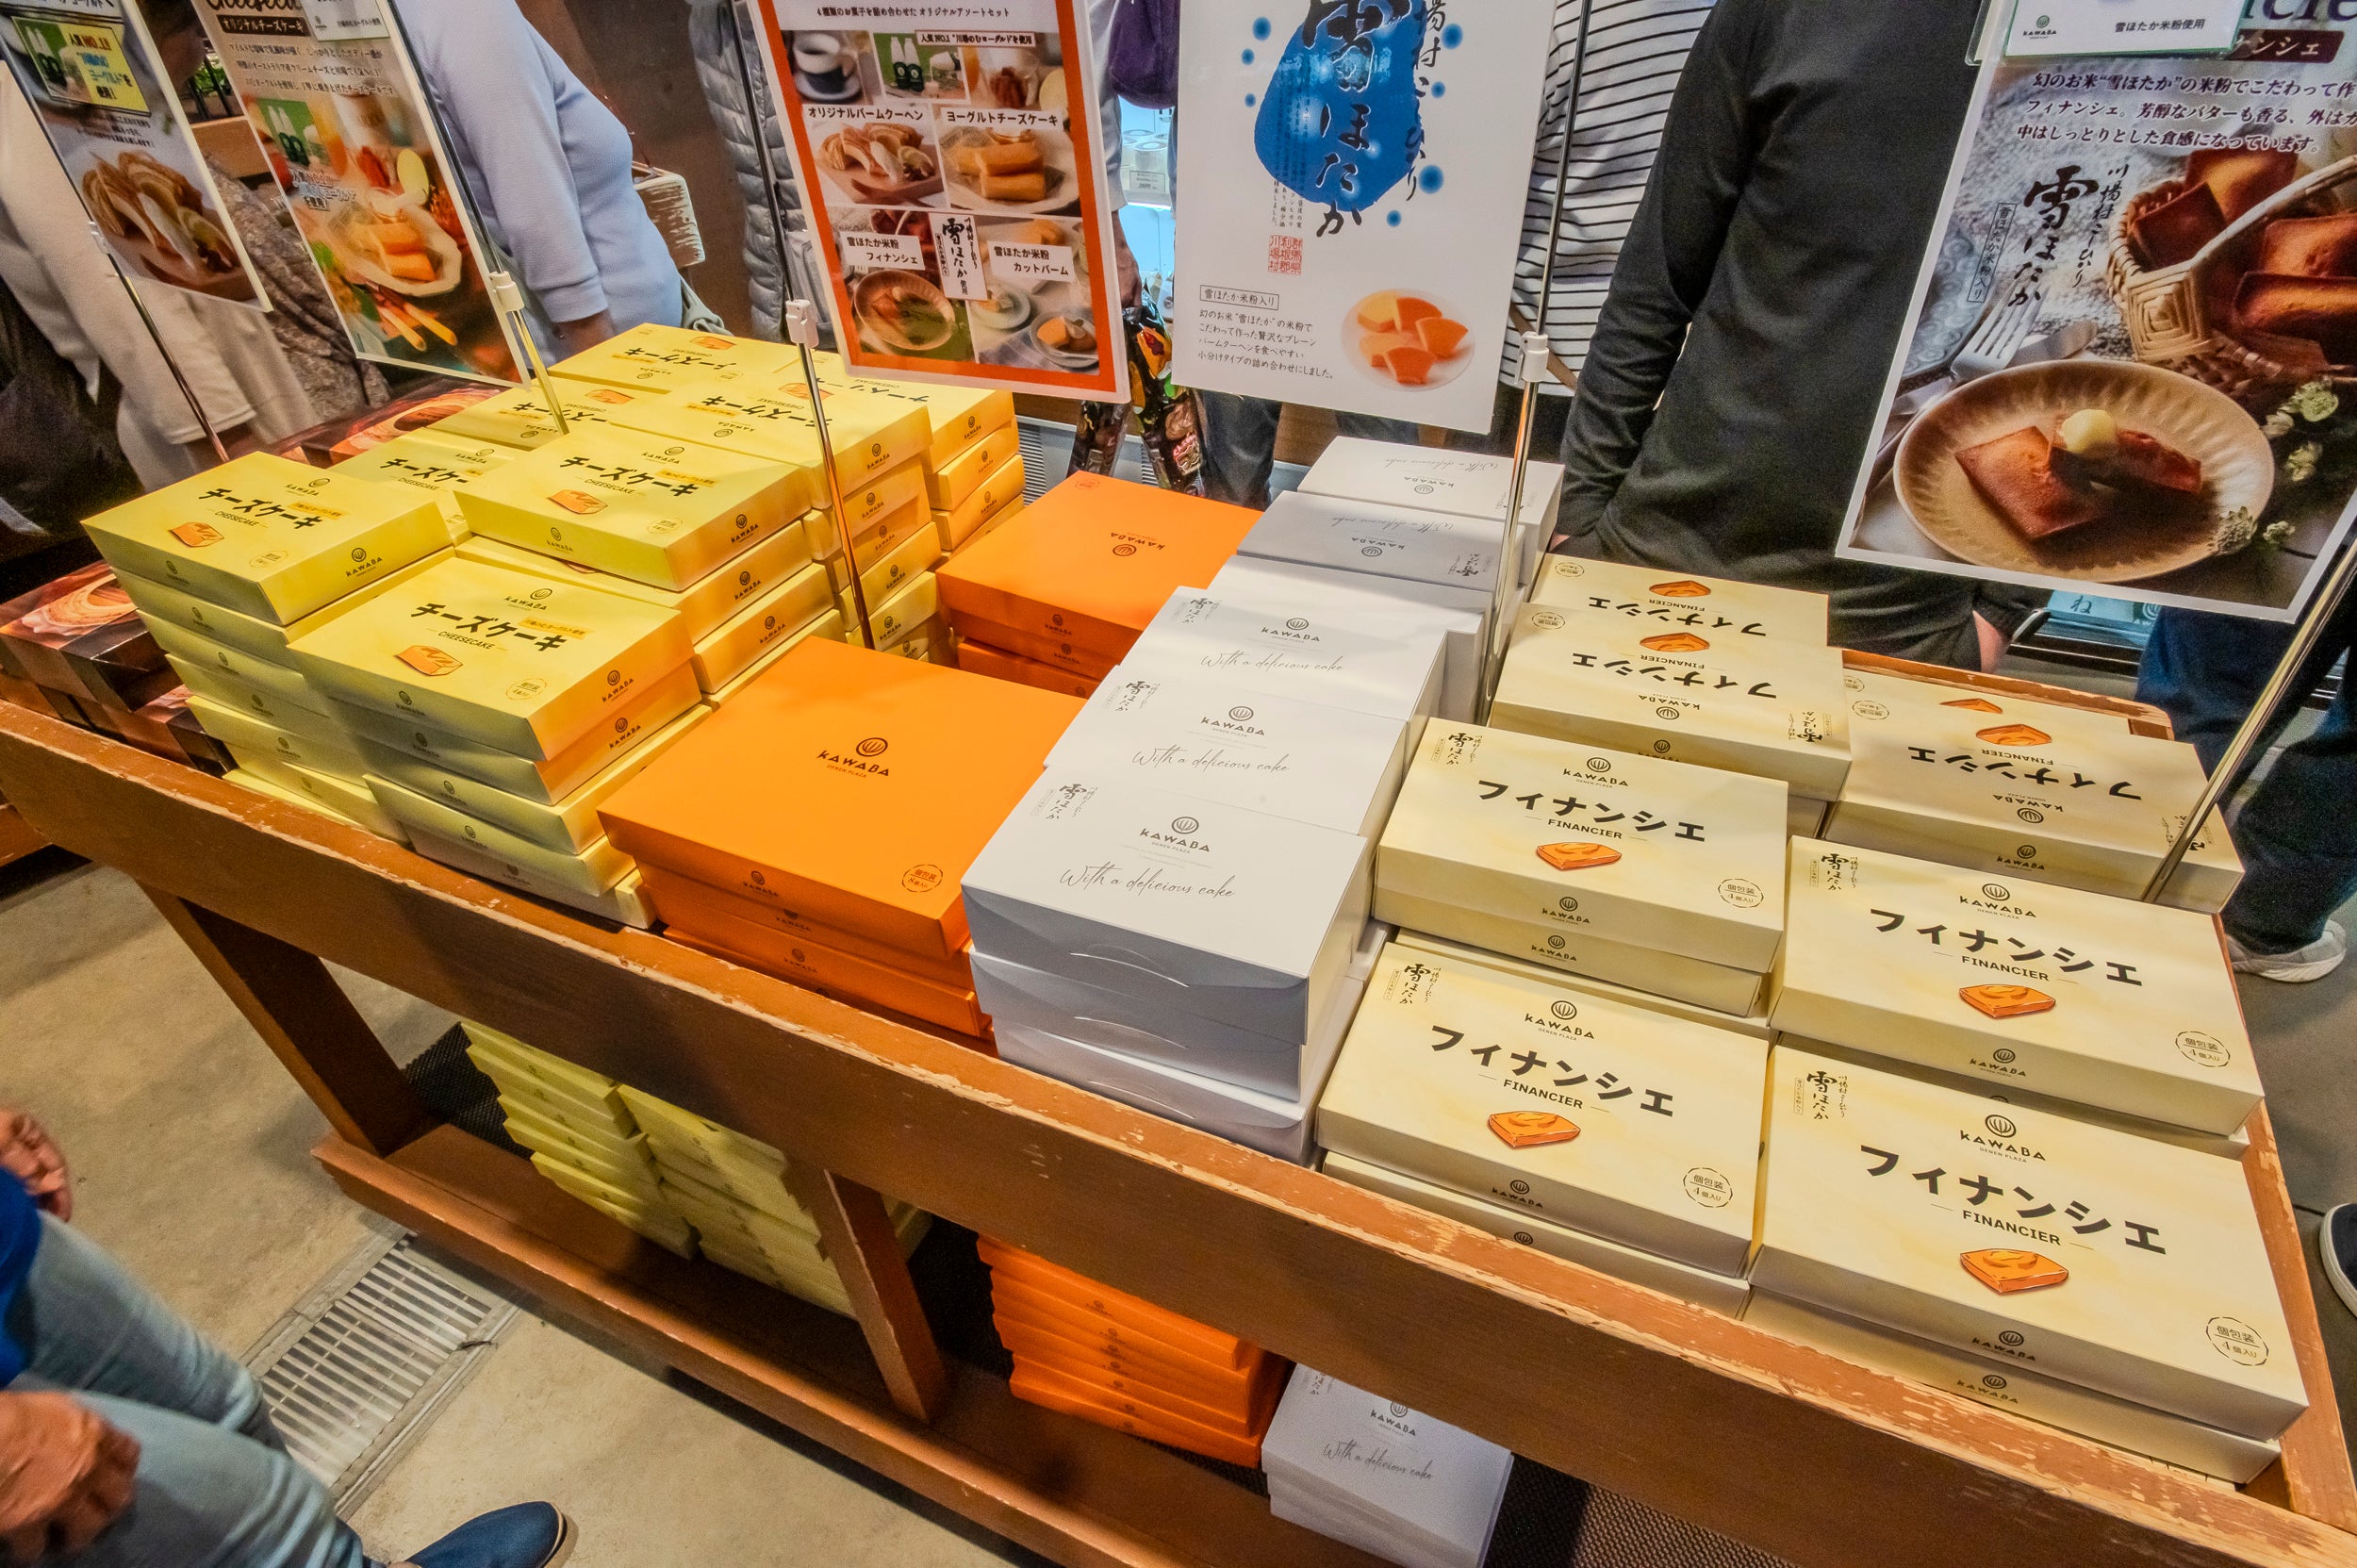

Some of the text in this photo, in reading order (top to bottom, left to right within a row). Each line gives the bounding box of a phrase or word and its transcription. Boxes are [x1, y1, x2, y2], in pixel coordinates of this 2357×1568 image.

[2115, 19, 2206, 33] 雪ほたか米粉使用
[2234, 36, 2320, 57] ンシェ
[808, 107, 923, 121] オリジナルバームクーヘン
[947, 111, 1058, 126] ヨーグルトチーズケーキ
[865, 252, 918, 265] フィナンシェ
[1014, 262, 1069, 276] カットバーム
[1204, 288, 1275, 306] 雪ほたか米粉入り
[560, 456, 700, 497] チーズケーキ
[585, 478, 635, 495] CHEESECAKE
[199, 488, 323, 529] チーズケーキ
[215, 511, 259, 527] CHEESECAKE
[1111, 532, 1166, 551] KAWABA
[1351, 536, 1405, 551] KAWABA
[346, 556, 383, 578] KAWABA
[734, 579, 762, 601] KAWABA
[504, 595, 548, 611] KAWABA
[1649, 599, 1706, 612] FINANCIER
[411, 602, 567, 652] チーズケーキ
[1589, 597, 1766, 636] フィナンシェ
[437, 631, 495, 650] CHEESECAKE
[760, 623, 786, 644] KAWABA
[1261, 626, 1321, 642] KAWABA
[1200, 650, 1253, 669] With
[1314, 655, 1345, 672] cake
[1640, 654, 1706, 669] FINANCIER
[1573, 652, 1776, 699] フィナンシェ
[602, 677, 635, 703] KAWABA
[1639, 694, 1701, 710] KAWABA
[609, 724, 641, 749] KAWABA
[1200, 717, 1265, 736] KAWABA
[816, 750, 890, 777] KAWABA
[1132, 744, 1188, 768] With
[1191, 749, 1252, 773] delicious
[1257, 753, 1290, 773] cake
[1982, 749, 2054, 765] FINANCIER
[1563, 768, 1628, 786] KAWABA
[1908, 746, 2142, 801] フィナンシェ
[1478, 780, 1705, 842] フィナンシェ
[1993, 793, 2064, 812] KAWABA
[1548, 818, 1623, 839] FINANCIER
[1140, 828, 1211, 852] KAWABA
[1997, 855, 2044, 870] KAWABA
[1059, 861, 1125, 891] With
[1126, 867, 1192, 897] delicious
[1197, 874, 1236, 899] cake
[1541, 907, 1591, 924] KAWABA
[1960, 896, 2036, 918] KAWABA
[1531, 944, 1577, 962] KAWABA
[1871, 908, 2143, 987] フィナンシェ
[1962, 955, 2050, 982] FINANCIER
[1525, 1013, 1595, 1040] KAWABA
[2185, 1037, 2219, 1051] 個包装
[1431, 1025, 1673, 1117] フィナンシェ
[1970, 1058, 2027, 1077] KAWABA
[1503, 1079, 1583, 1109] FINANCIER
[1807, 1071, 1838, 1120] 雪ほたか
[1960, 1130, 2046, 1162] KAWABA
[1979, 1147, 2027, 1164] DENEN PLAZA
[1693, 1174, 1724, 1190] 個包装
[1492, 1186, 1543, 1208] KAWABA
[1860, 1145, 2167, 1255] フィナンシェ
[1963, 1210, 2061, 1246] FINANCIER
[2217, 1325, 2255, 1345] 個包装
[1971, 1335, 2036, 1362] KAWABA
[1370, 1409, 1416, 1436] KAWABA
